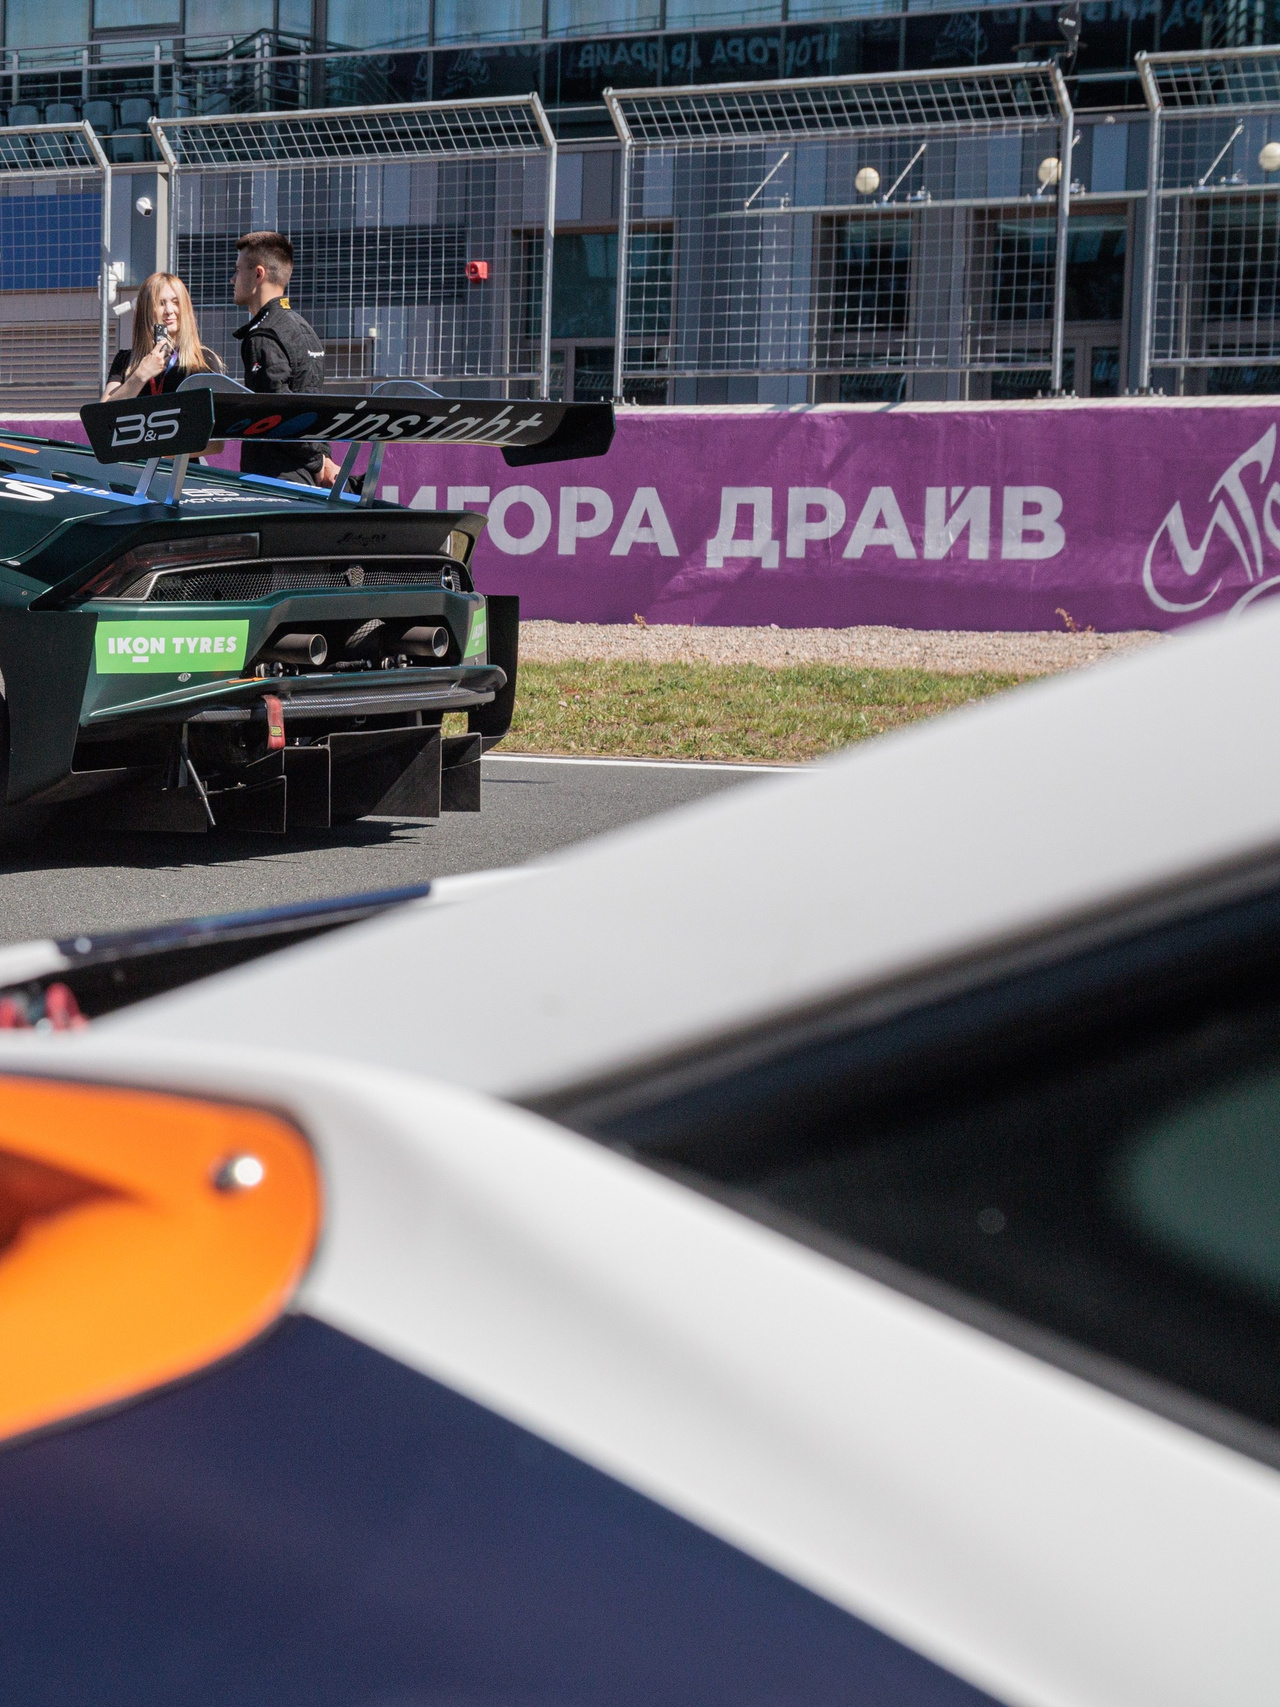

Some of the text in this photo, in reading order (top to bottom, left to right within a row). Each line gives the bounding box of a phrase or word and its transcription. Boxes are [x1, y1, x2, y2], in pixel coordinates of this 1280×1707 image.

[299, 399, 544, 447] insight
[705, 485, 1066, 569] ДРАЙВ
[108, 635, 238, 658] IKON TYRES
